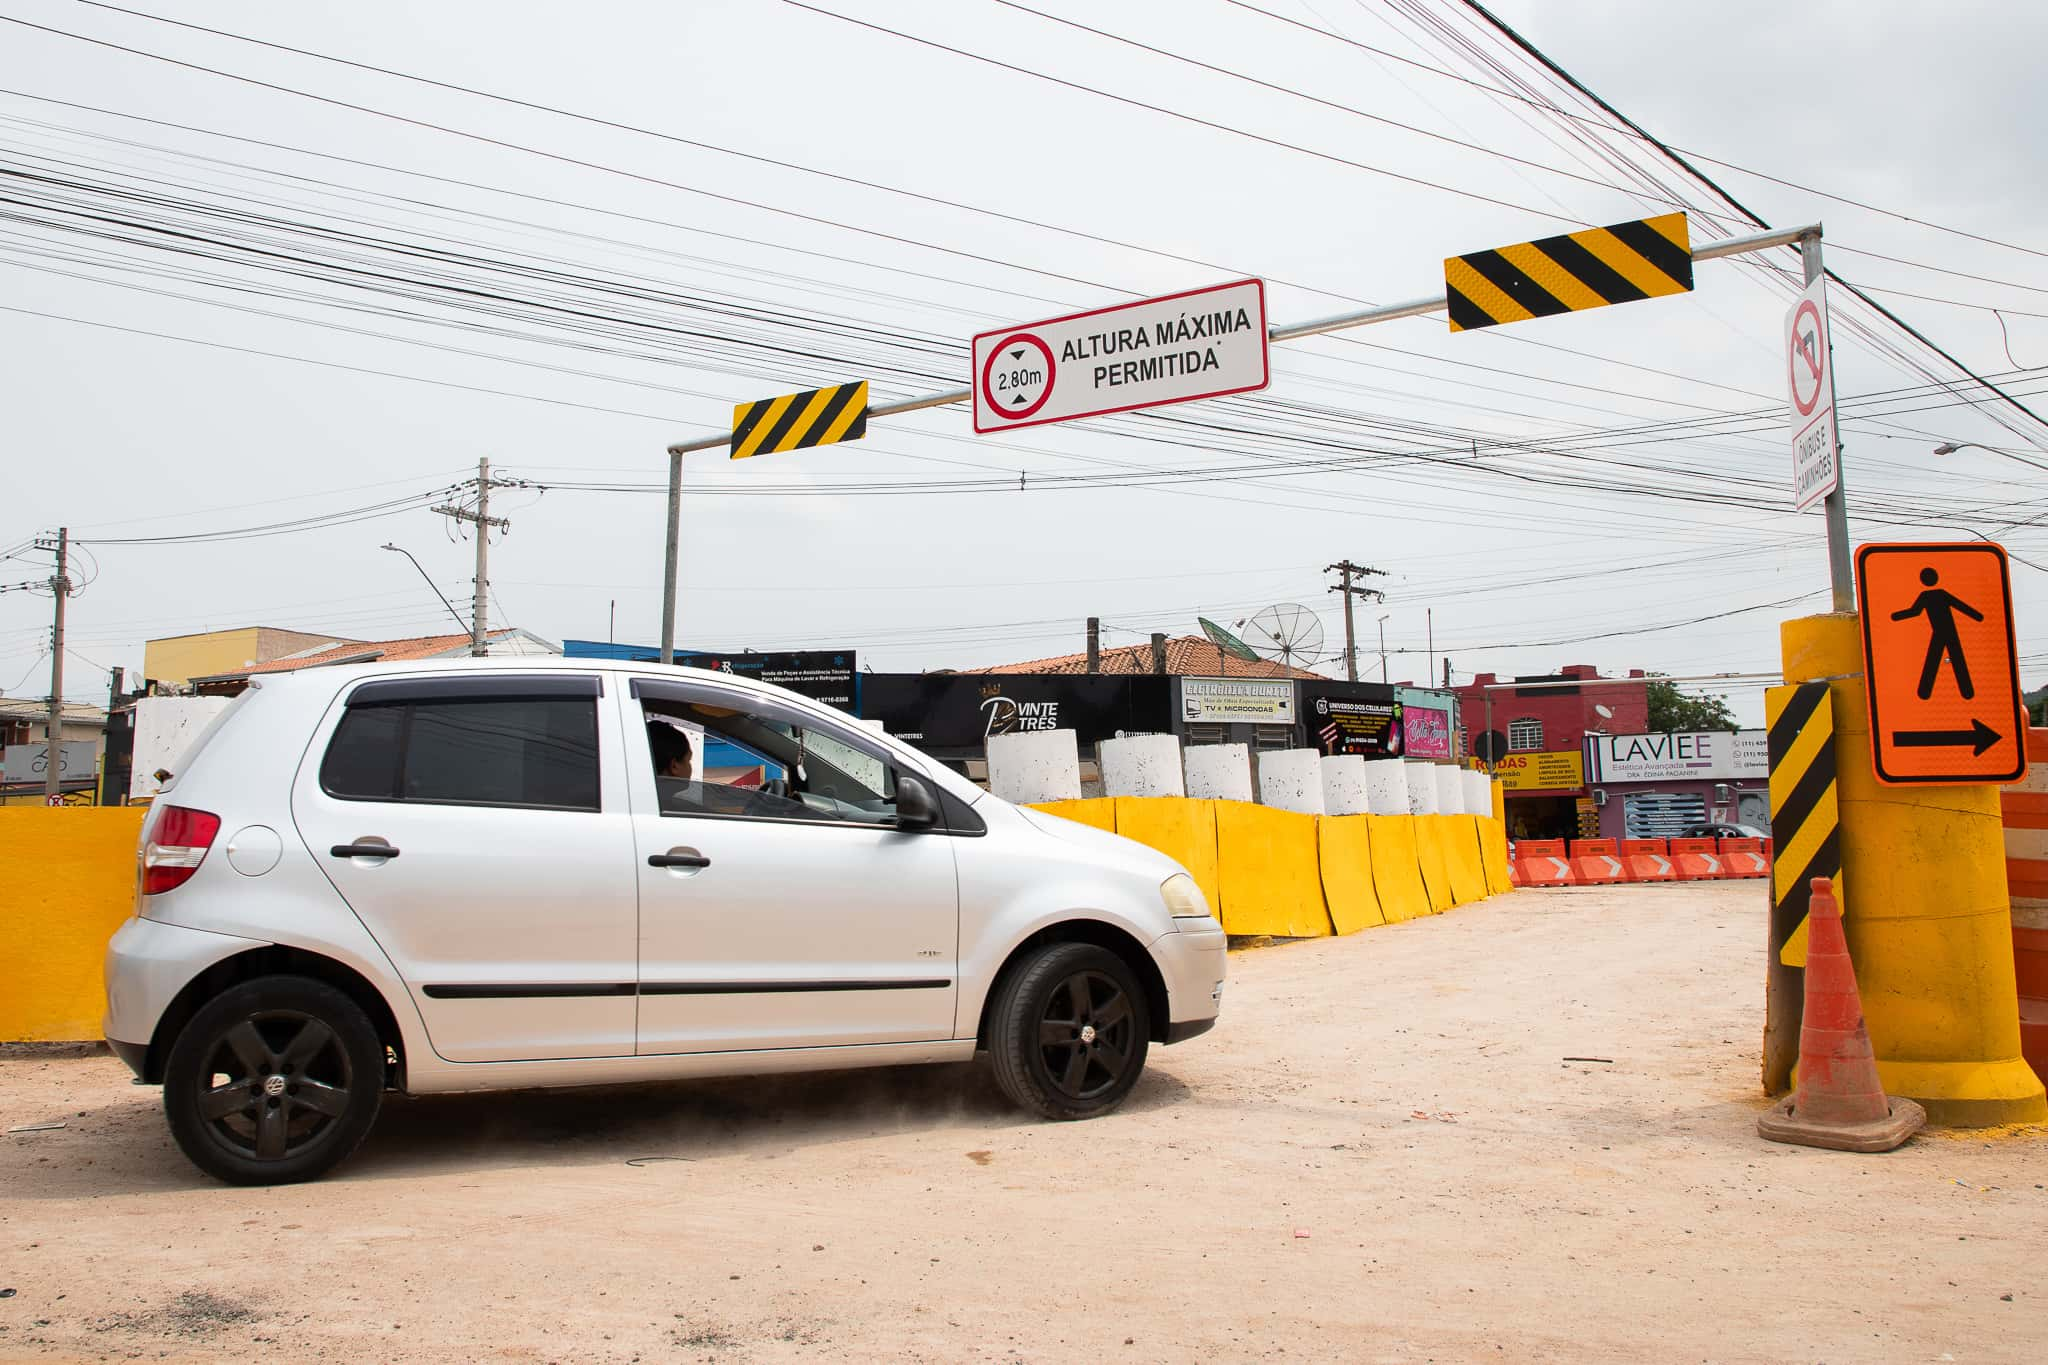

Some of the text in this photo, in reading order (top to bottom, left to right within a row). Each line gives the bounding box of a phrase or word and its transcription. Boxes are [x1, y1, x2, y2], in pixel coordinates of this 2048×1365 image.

[1061, 307, 1252, 363] ALTURA MÁXIMA
[1094, 347, 1220, 389] PERMITIDA
[1799, 425, 1826, 464] ÔNIBUS E
[1797, 453, 1832, 496] CAMINHÕES
[1017, 702, 1059, 717] VINTE
[1328, 702, 1354, 710] UNIVERSO
[1354, 703, 1366, 711] DOS
[1366, 704, 1393, 712] CELULARES
[1018, 715, 1057, 730] TRÊS
[1612, 762, 1684, 771] Estética Avançada
